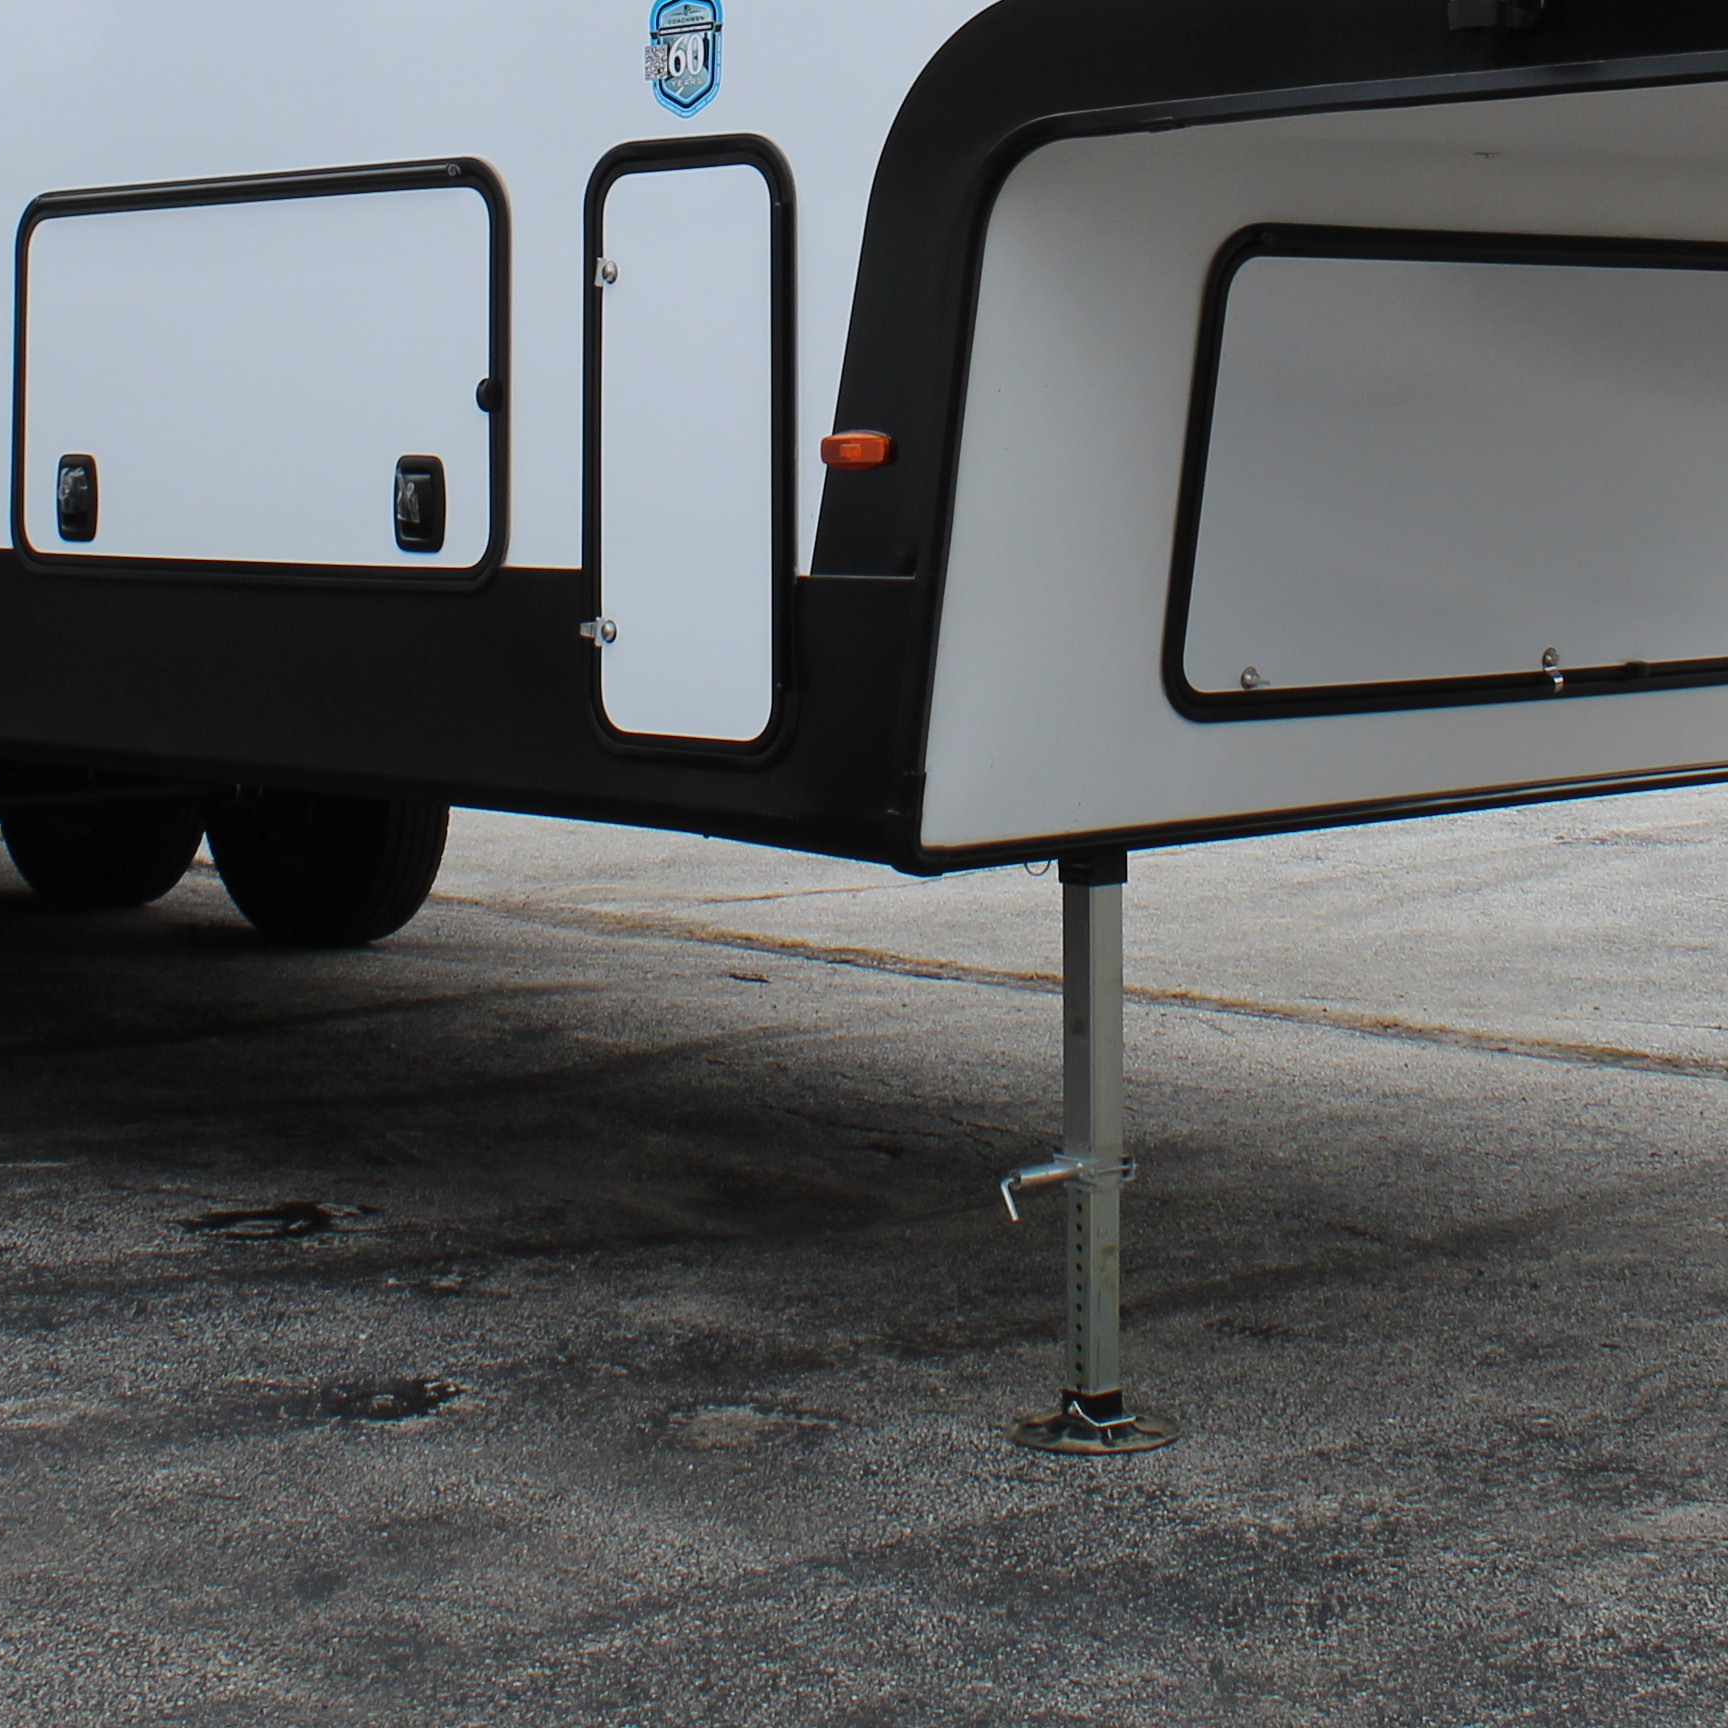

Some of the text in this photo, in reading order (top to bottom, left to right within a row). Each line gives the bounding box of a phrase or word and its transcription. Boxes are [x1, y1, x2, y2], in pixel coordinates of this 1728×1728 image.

[667, 16, 705, 26] COACHMEN
[668, 33, 705, 78] 60
[670, 78, 704, 88] YEARS
